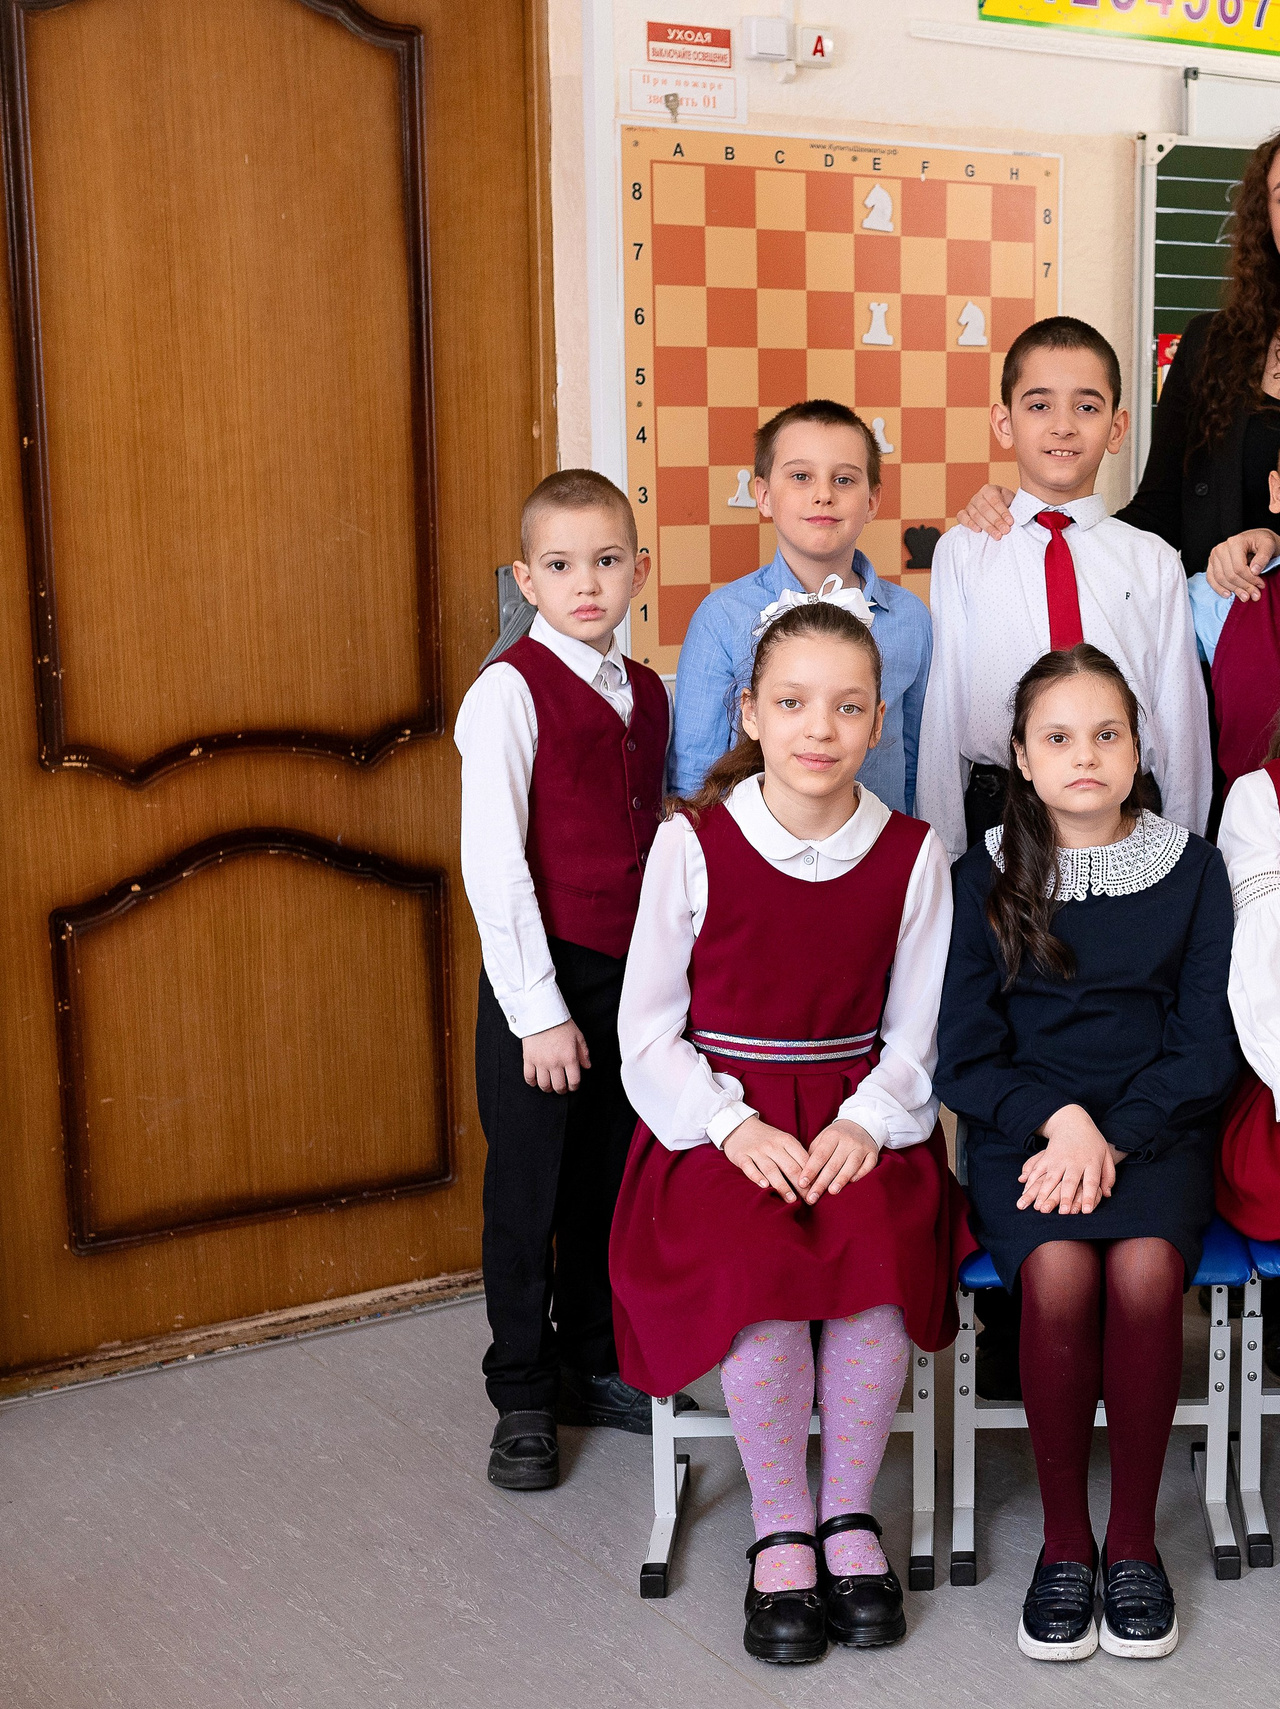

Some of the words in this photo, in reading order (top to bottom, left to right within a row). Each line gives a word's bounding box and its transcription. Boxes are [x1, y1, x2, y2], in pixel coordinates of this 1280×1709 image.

[666, 28, 712, 44] УХОДЯ
[812, 35, 825, 58] А
[642, 74, 668, 86] При
[675, 79, 724, 91] пожаре
[702, 95, 717, 109] 01
[673, 143, 685, 157] A
[724, 146, 735, 160] B
[775, 150, 785, 164] C
[824, 154, 835, 168] D
[872, 157, 882, 171] E
[921, 161, 930, 175] F
[965, 164, 975, 178] G
[1010, 168, 1019, 181] H
[632, 182, 643, 200] 8
[1043, 208, 1052, 225] 8
[633, 243, 643, 261] 7
[1043, 262, 1052, 278] 7
[634, 307, 645, 325] 6
[635, 368, 646, 385] 5
[636, 426, 647, 443] 4
[638, 486, 648, 504] 3
[640, 604, 648, 622] 1
